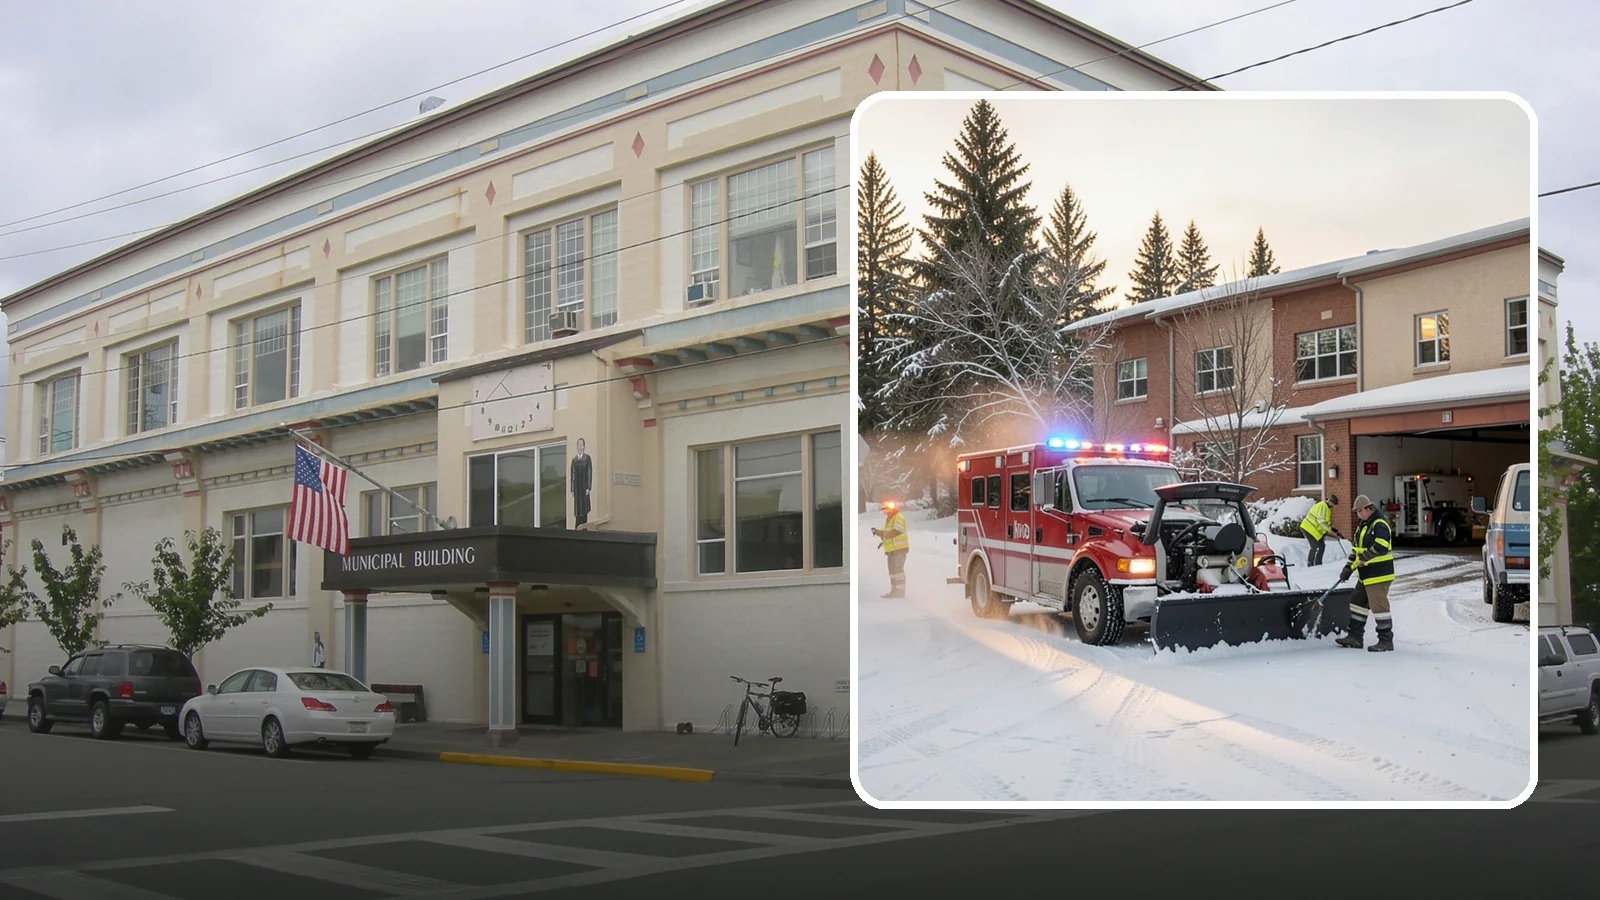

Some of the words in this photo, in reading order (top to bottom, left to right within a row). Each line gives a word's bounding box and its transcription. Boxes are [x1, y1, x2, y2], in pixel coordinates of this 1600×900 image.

[475, 390, 479, 398] 7
[536, 402, 540, 410] 4
[481, 407, 485, 415] 8
[488, 418, 492, 426] 9
[529, 414, 533, 422] 3
[494, 424, 500, 432] 10
[521, 420, 525, 428] 2
[507, 425, 513, 433] 12
[342, 552, 405, 571] MUNICIPAL
[414, 546, 475, 567] BUILDING
